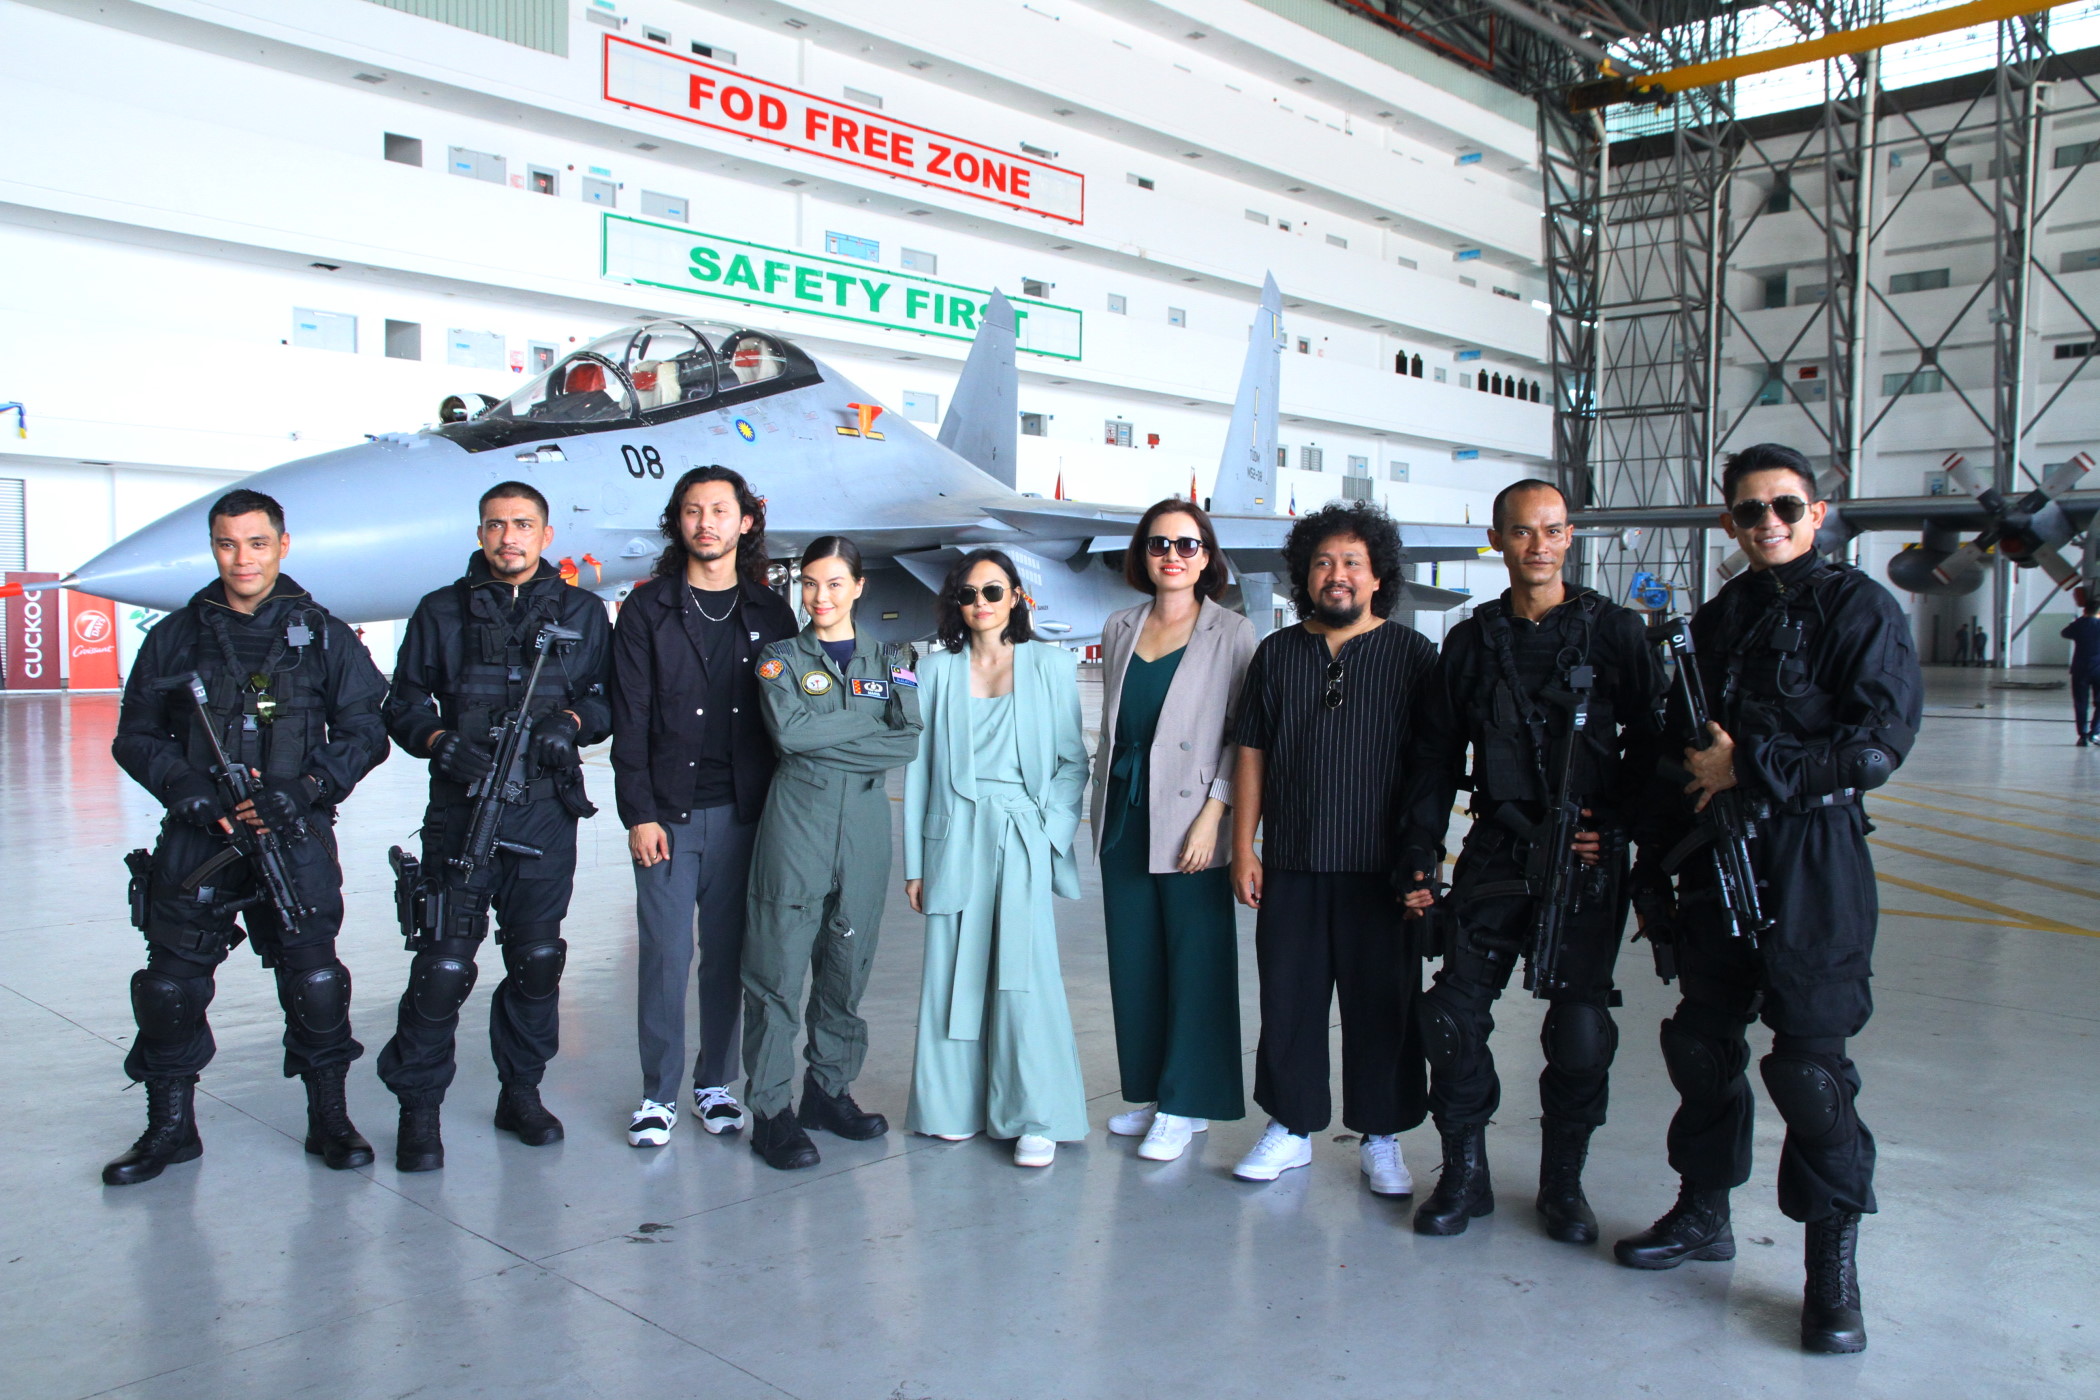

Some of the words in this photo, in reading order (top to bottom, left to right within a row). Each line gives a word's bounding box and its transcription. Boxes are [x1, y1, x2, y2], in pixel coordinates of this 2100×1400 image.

[689, 74, 788, 131] FOD
[805, 107, 915, 168] FREE
[926, 143, 1031, 199] ZONE
[688, 246, 891, 313] SAFETY
[906, 287, 1029, 338] FIRT
[621, 444, 665, 479] 08
[80, 615, 101, 638] 7
[92, 616, 106, 638] DAYS
[72, 644, 115, 658] Croissant
